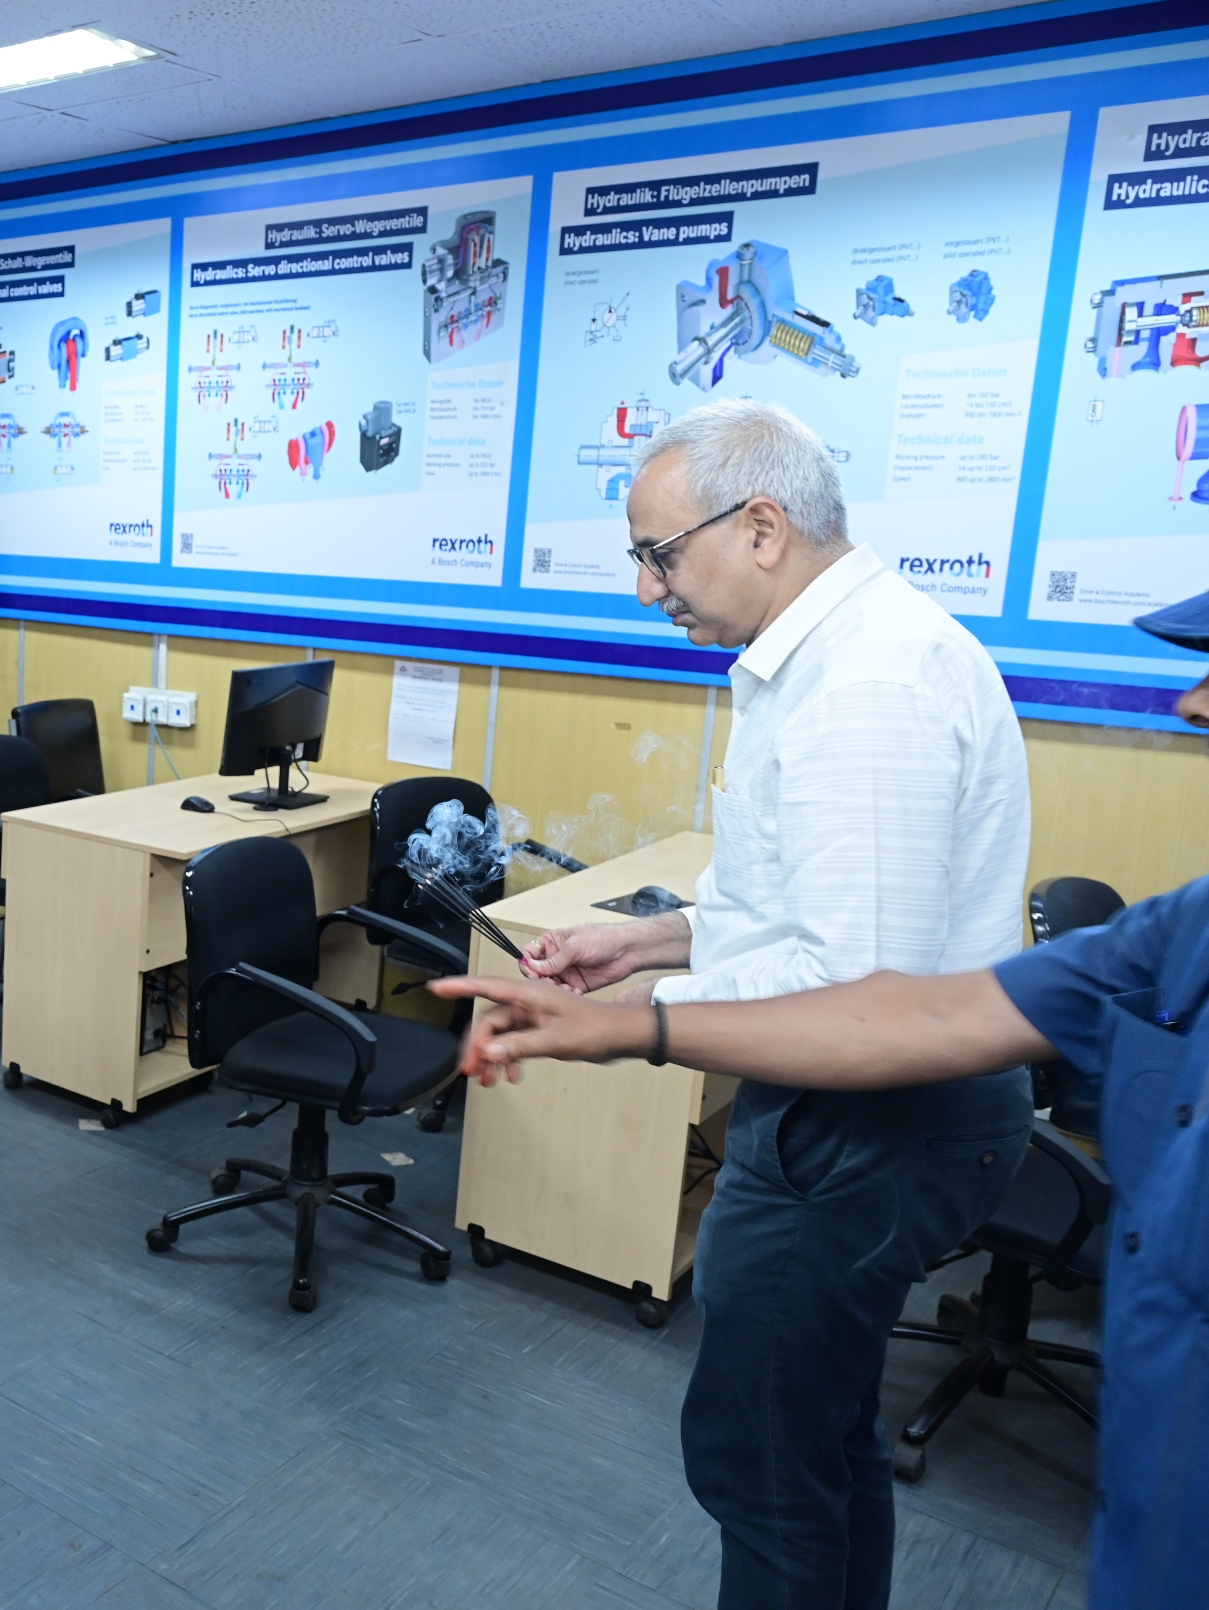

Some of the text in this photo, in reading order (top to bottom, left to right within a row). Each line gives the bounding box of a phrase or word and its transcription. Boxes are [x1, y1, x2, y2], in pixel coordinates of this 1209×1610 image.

[587, 172, 810, 213] Hydraulik: Flügelzellenpumpen
[1112, 175, 1209, 204] Hydraulic
[267, 213, 424, 246] Hydraulik: Servo-Wegeventile
[564, 221, 728, 250] Hydraulics: Vane pumps
[0, 251, 73, 271] Schalt-Wegeventile
[193, 249, 409, 284] Hydraulics: Servo directional control valves
[10, 283, 37, 298] control
[38, 281, 63, 294] valves
[109, 518, 153, 537] rexroth
[114, 539, 129, 547] Bosch
[130, 540, 153, 550] Company
[432, 533, 494, 555] rexroth
[431, 557, 492, 570] A Bosch Company
[899, 552, 991, 579] rexroth
[941, 582, 988, 597] Company
